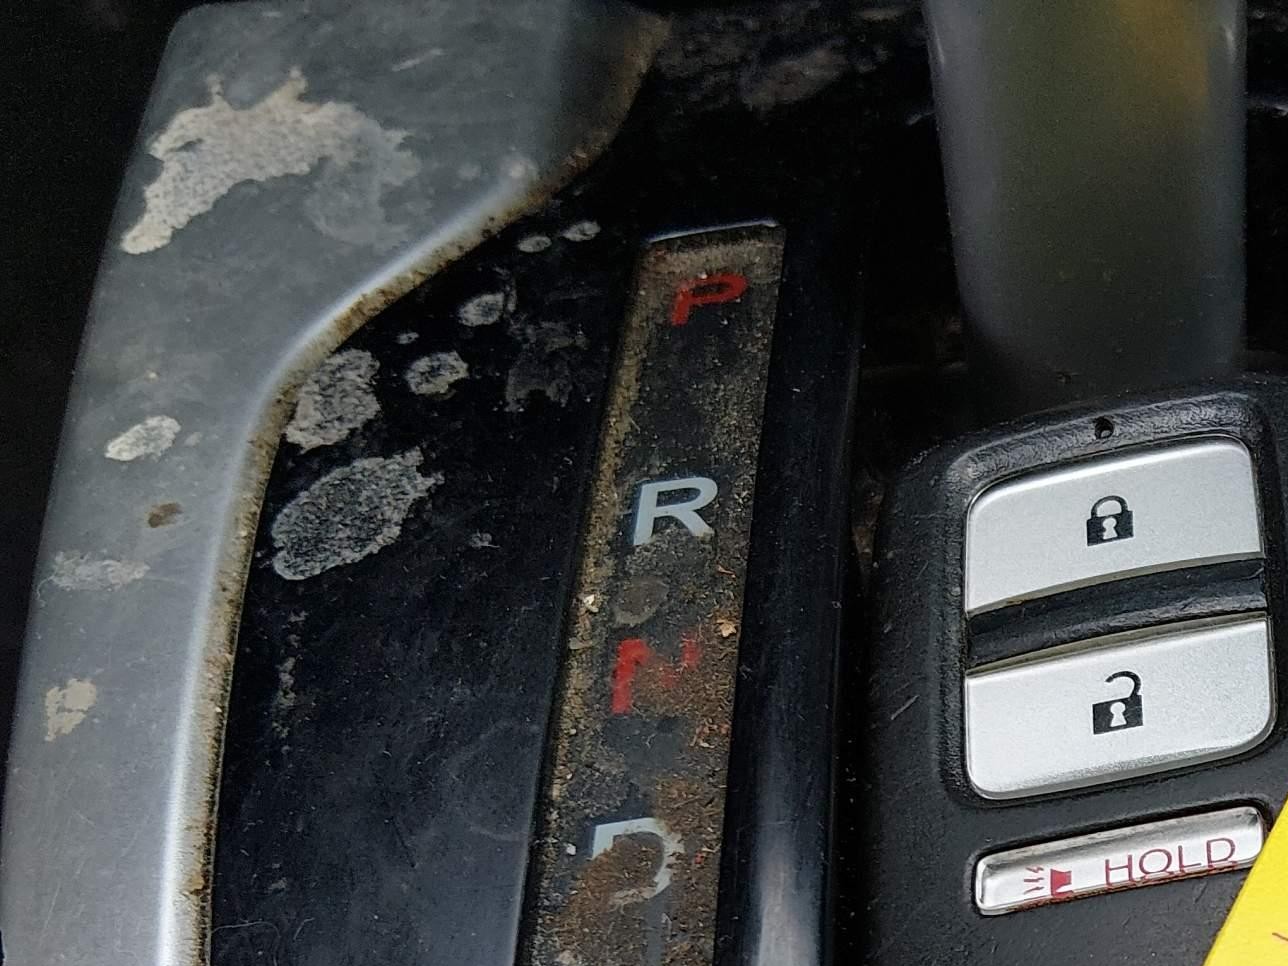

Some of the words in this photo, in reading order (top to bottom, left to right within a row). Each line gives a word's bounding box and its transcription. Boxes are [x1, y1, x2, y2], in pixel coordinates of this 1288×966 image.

[671, 273, 748, 326] P
[633, 476, 718, 546] R
[1104, 837, 1237, 888] HOLD
